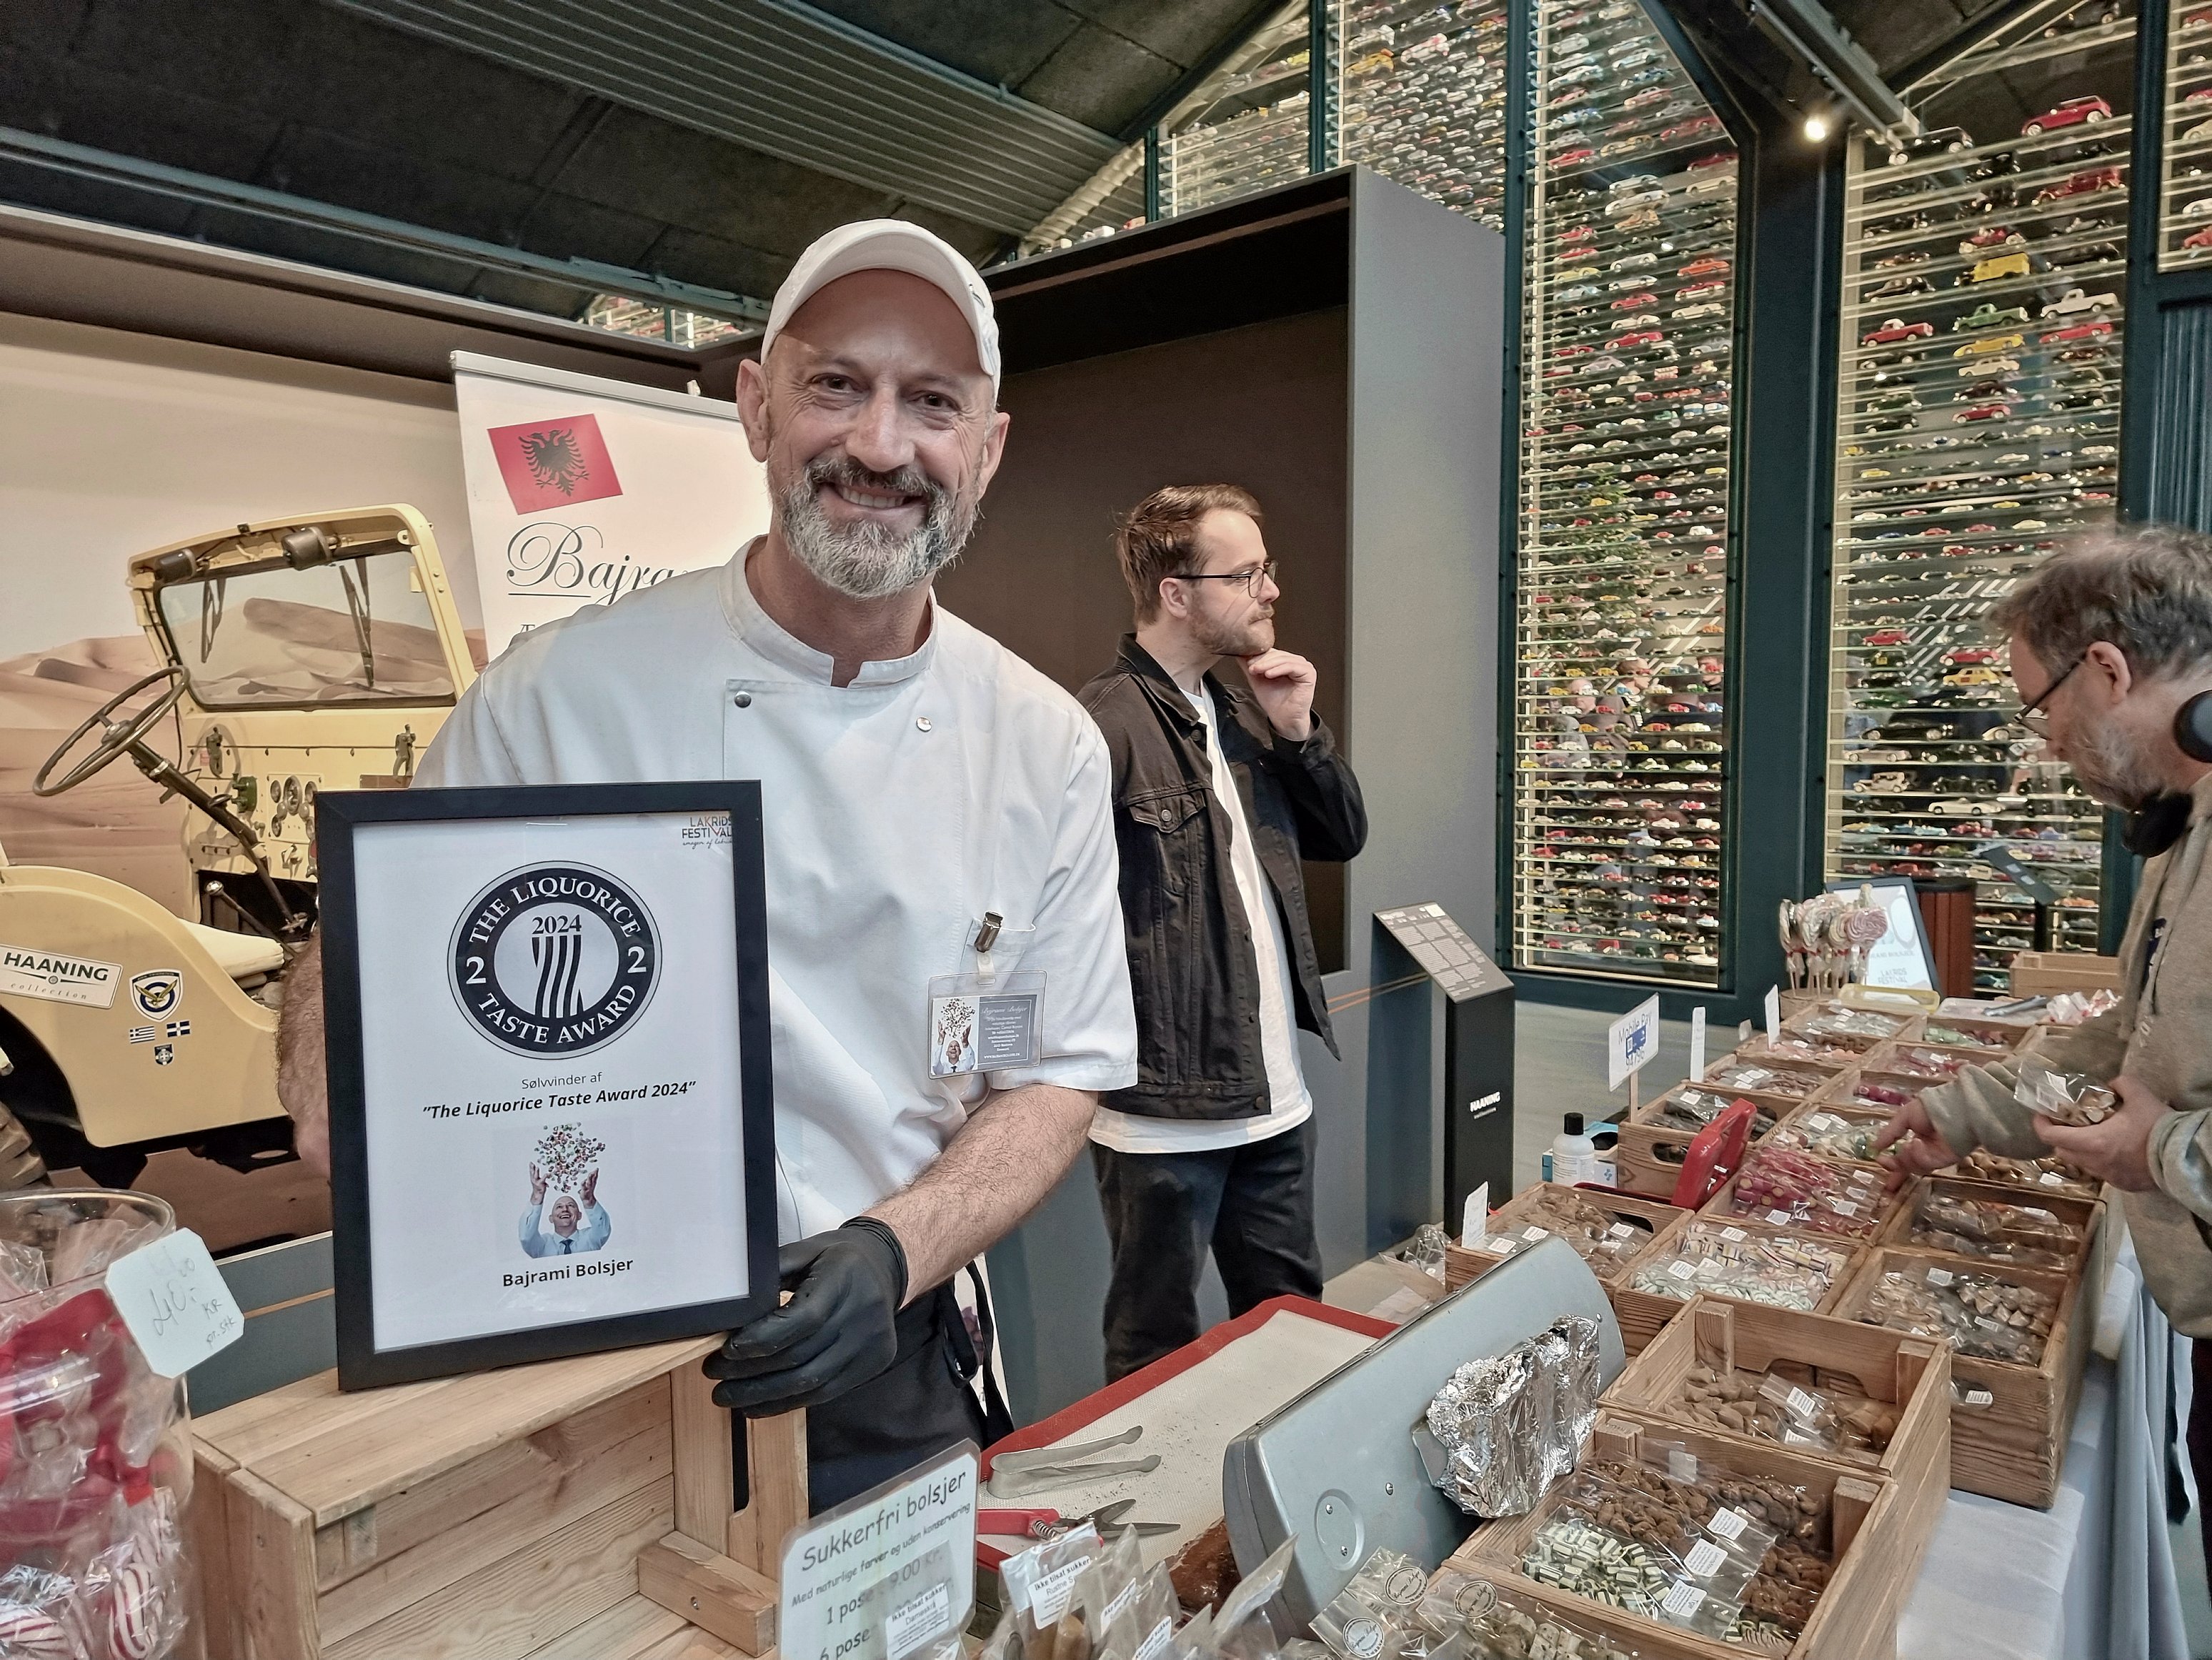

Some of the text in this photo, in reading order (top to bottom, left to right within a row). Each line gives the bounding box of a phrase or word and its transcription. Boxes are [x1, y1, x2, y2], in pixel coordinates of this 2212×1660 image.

[469, 877, 642, 943] THE LIQUORICE
[532, 914, 582, 935] 2024
[4, 952, 109, 981] HAANING
[466, 956, 487, 985] 2
[627, 945, 647, 973] 2
[11, 983, 87, 1000] collection
[478, 985, 636, 1044] TASTE AWARD
[522, 1072, 603, 1089] Sølvvinder af
[466, 1097, 543, 1118] Liquorice
[549, 1093, 592, 1108] Taste
[596, 1085, 648, 1103] Award
[503, 1259, 634, 1288] Bajrami Bolsjer
[802, 1471, 967, 1571] Sukkerfri bolsjer
[792, 1503, 971, 1607] Med naturlige farver og uden konservering
[1034, 1580, 1049, 1591] Ikke
[1067, 1558, 1090, 1574] sukker
[827, 1606, 833, 1625] 1
[836, 1629, 870, 1660] pose
